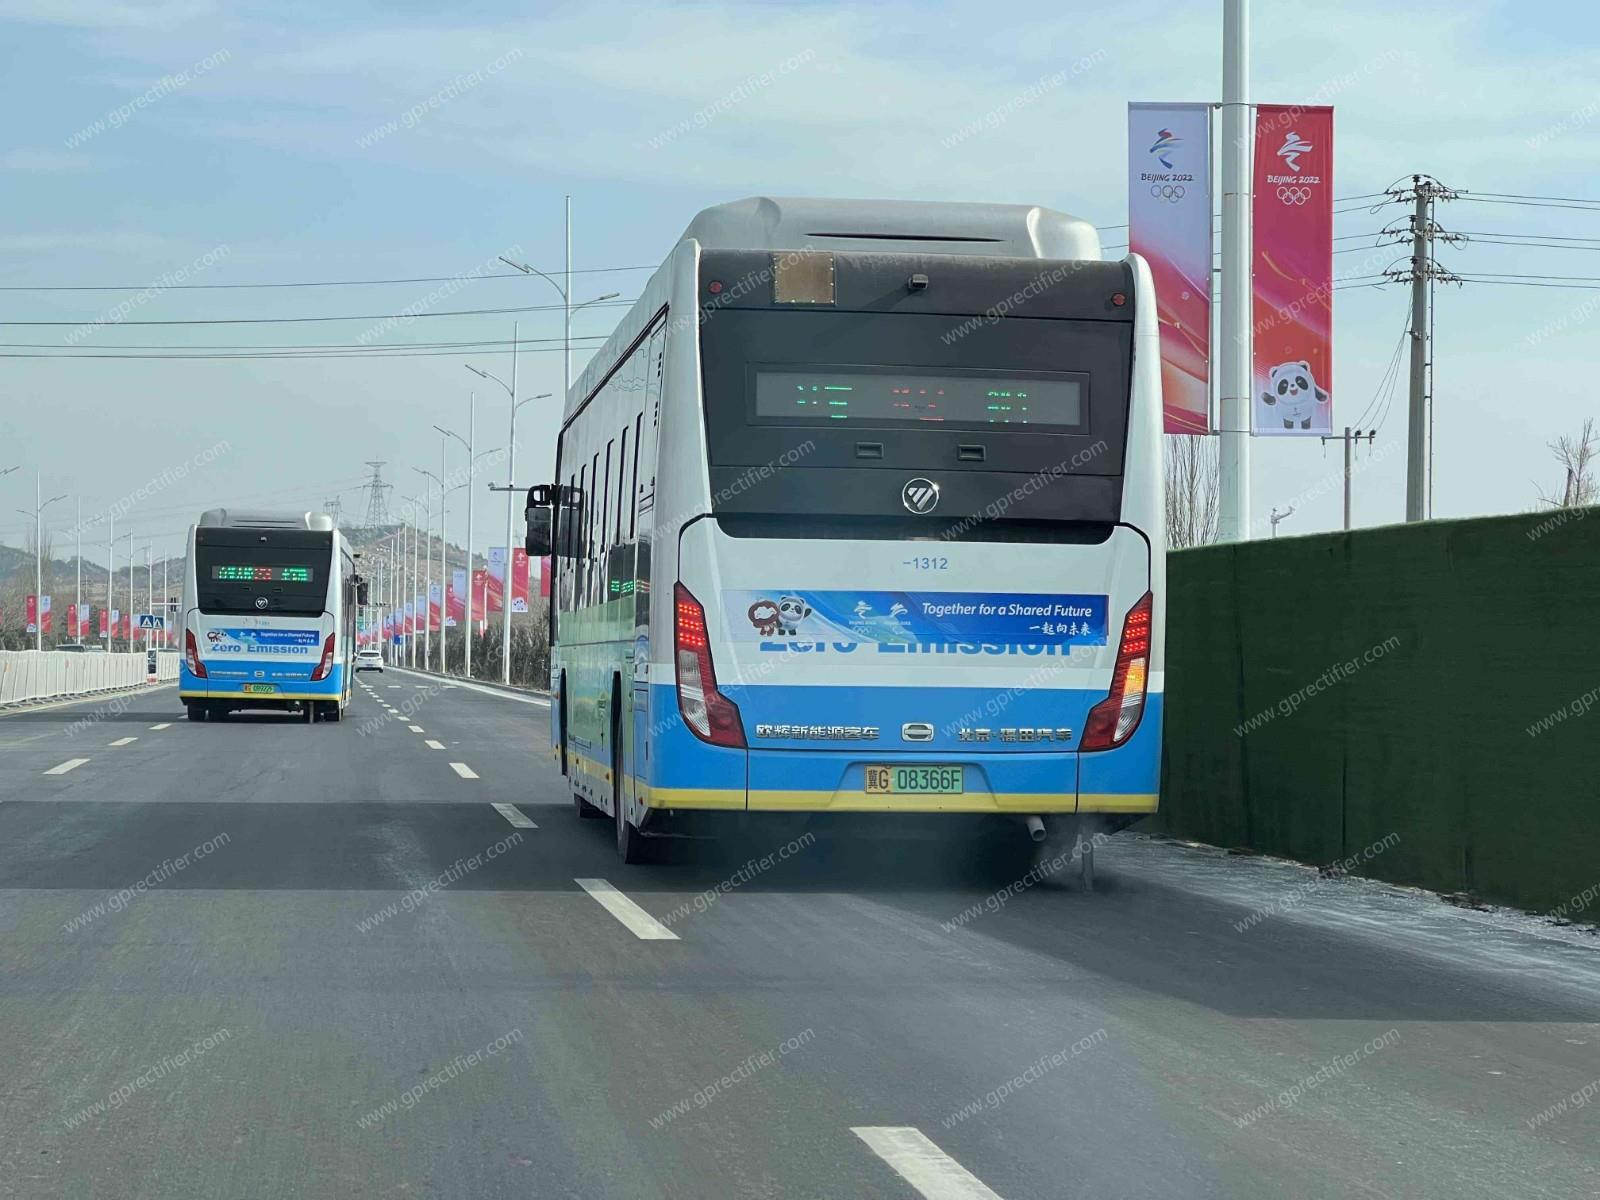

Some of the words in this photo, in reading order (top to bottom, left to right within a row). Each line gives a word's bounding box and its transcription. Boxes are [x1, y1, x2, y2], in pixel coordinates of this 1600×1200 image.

[1141, 173, 1169, 182] BEIJING
[1172, 174, 1193, 182] 2022
[1267, 174, 1296, 183] BEIJING
[1299, 175, 1320, 183] 2022
[922, 602, 978, 617] Together
[979, 603, 996, 616] for
[998, 606, 1006, 616] a
[1008, 603, 1051, 616] Shared
[1054, 604, 1092, 617] Future
[1029, 621, 1092, 636] 一起向未来
[756, 724, 880, 740] 欧辉新能源客车
[897, 769, 961, 790] 08366F
